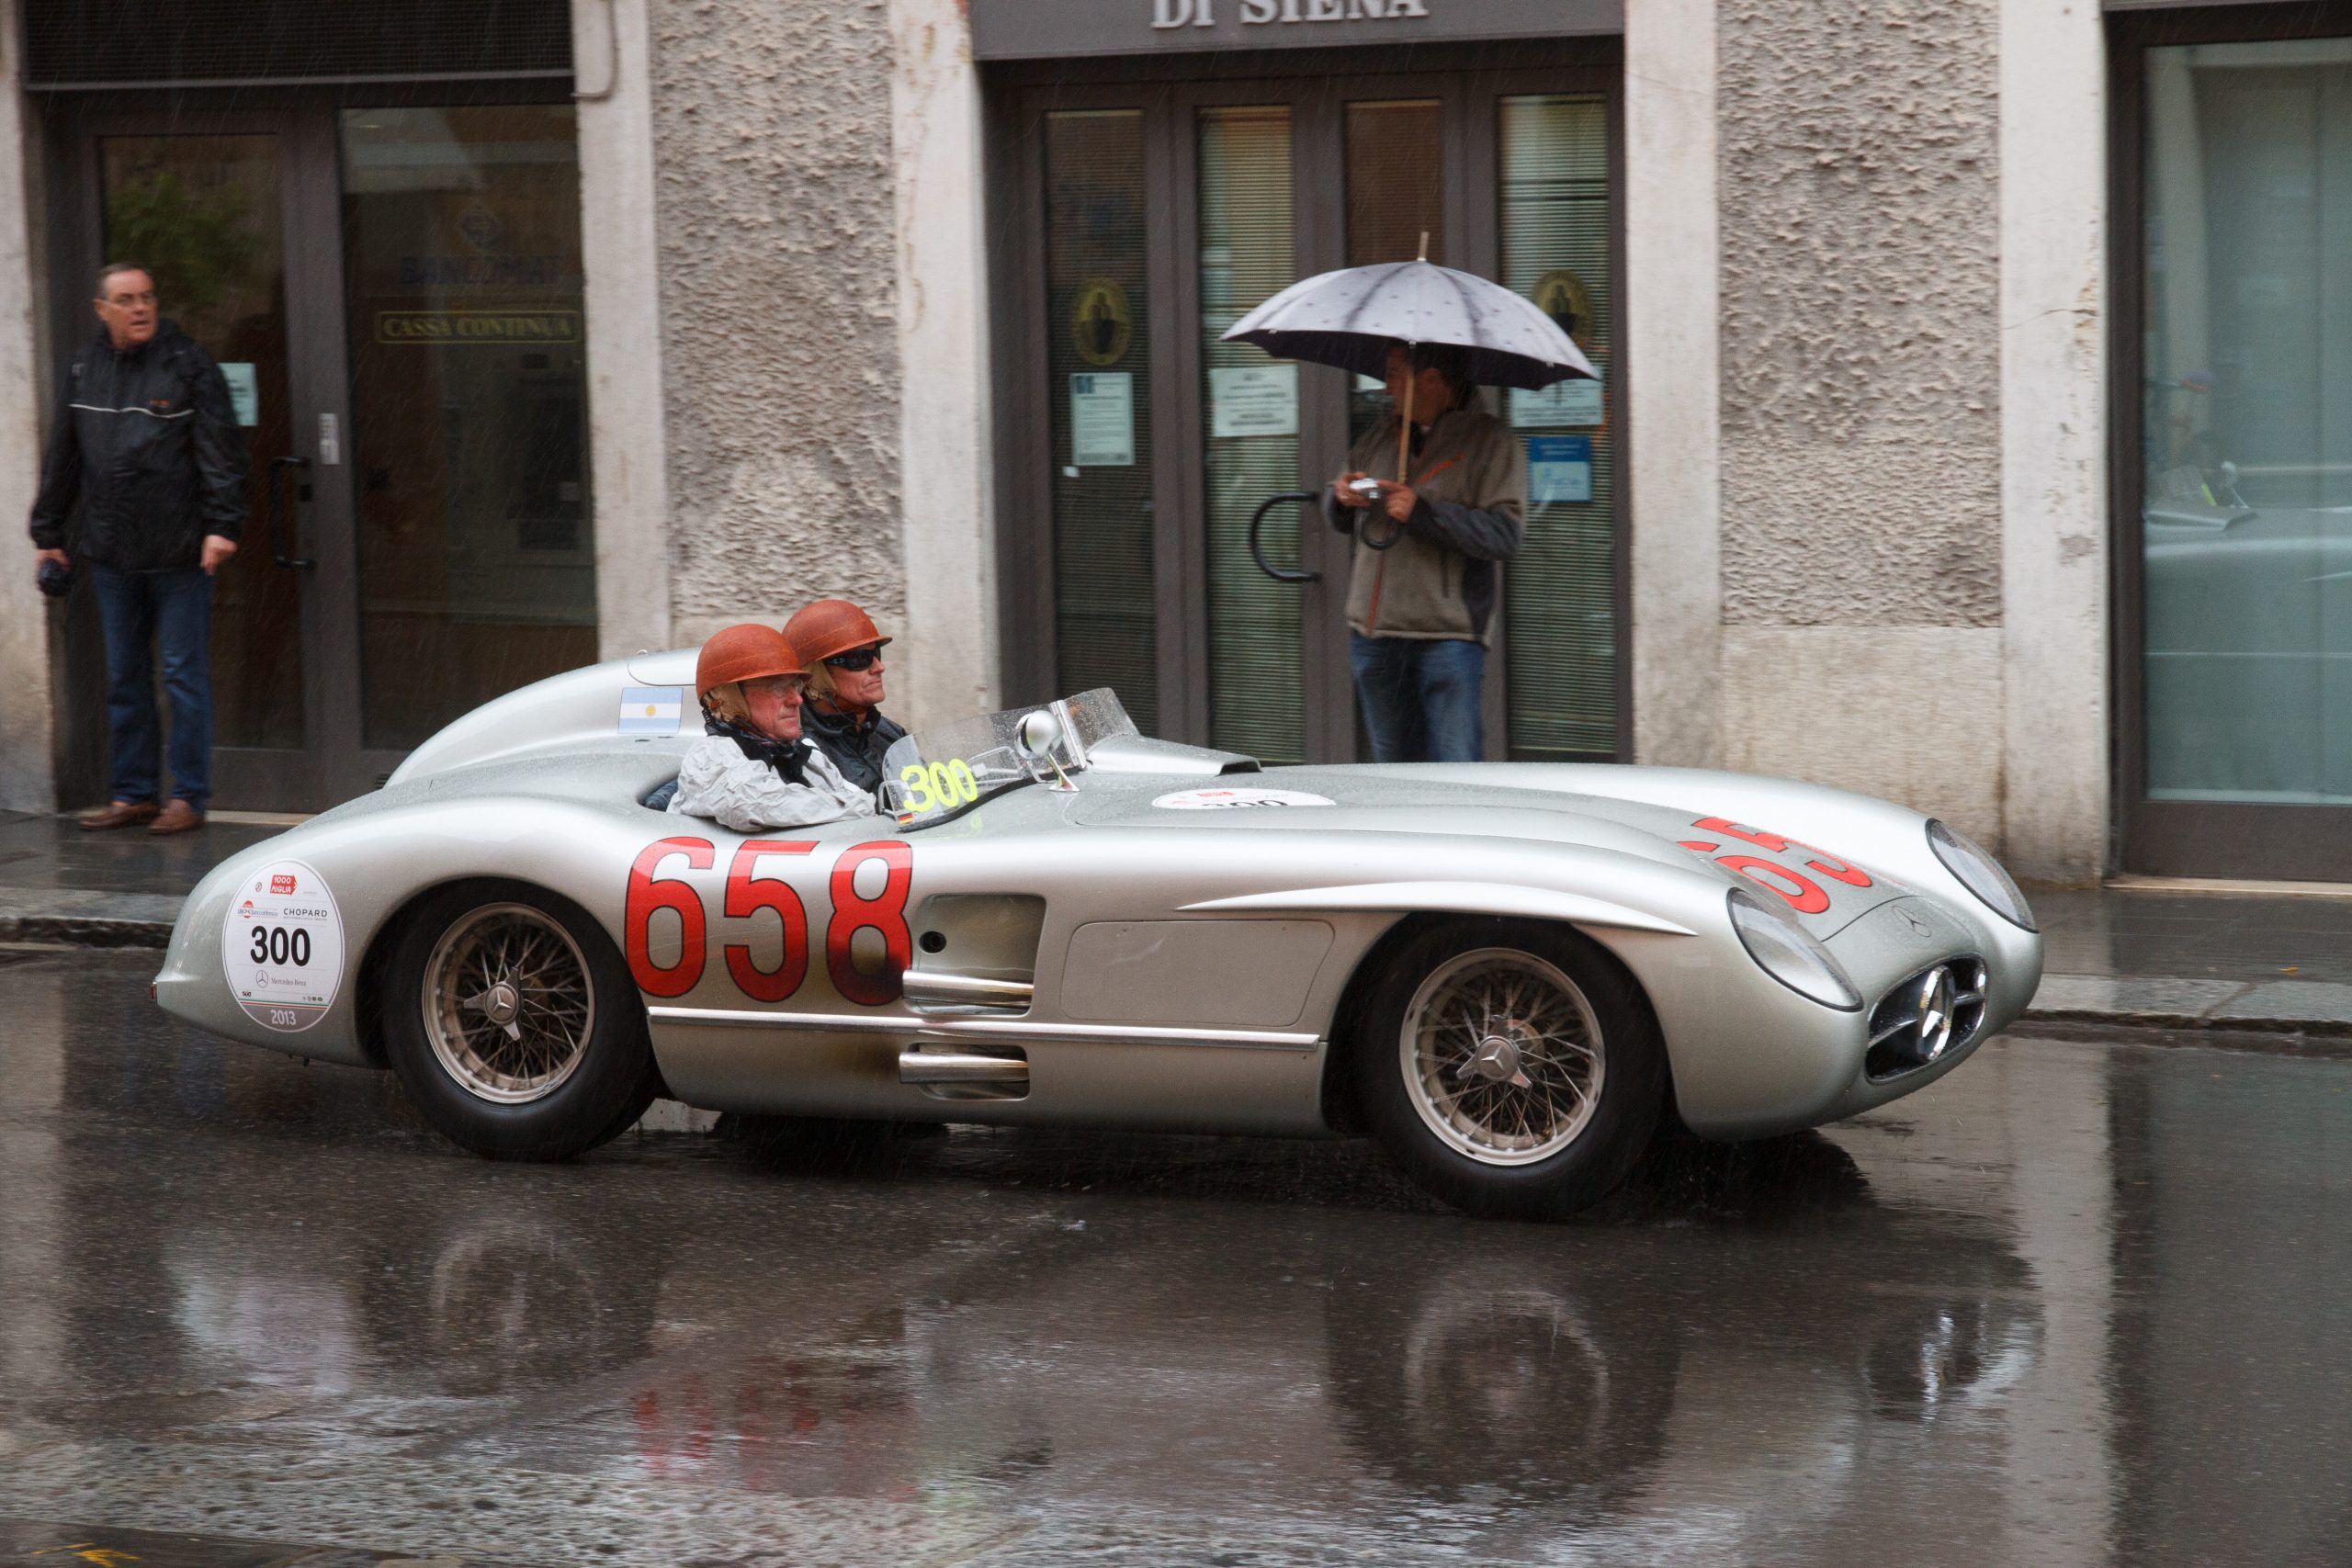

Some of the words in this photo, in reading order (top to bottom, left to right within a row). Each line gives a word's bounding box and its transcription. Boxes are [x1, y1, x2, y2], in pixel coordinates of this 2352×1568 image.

[1151, 0, 1216, 28] DI
[383, 318, 452, 337] CASSA
[900, 758, 978, 812] 300
[270, 885, 291, 894] MIGLIA
[274, 875, 291, 885] 1000
[283, 908, 328, 918] CHOPARD
[624, 836, 912, 1006] 658
[251, 925, 311, 967] 300
[270, 1009, 297, 1025] 2013
